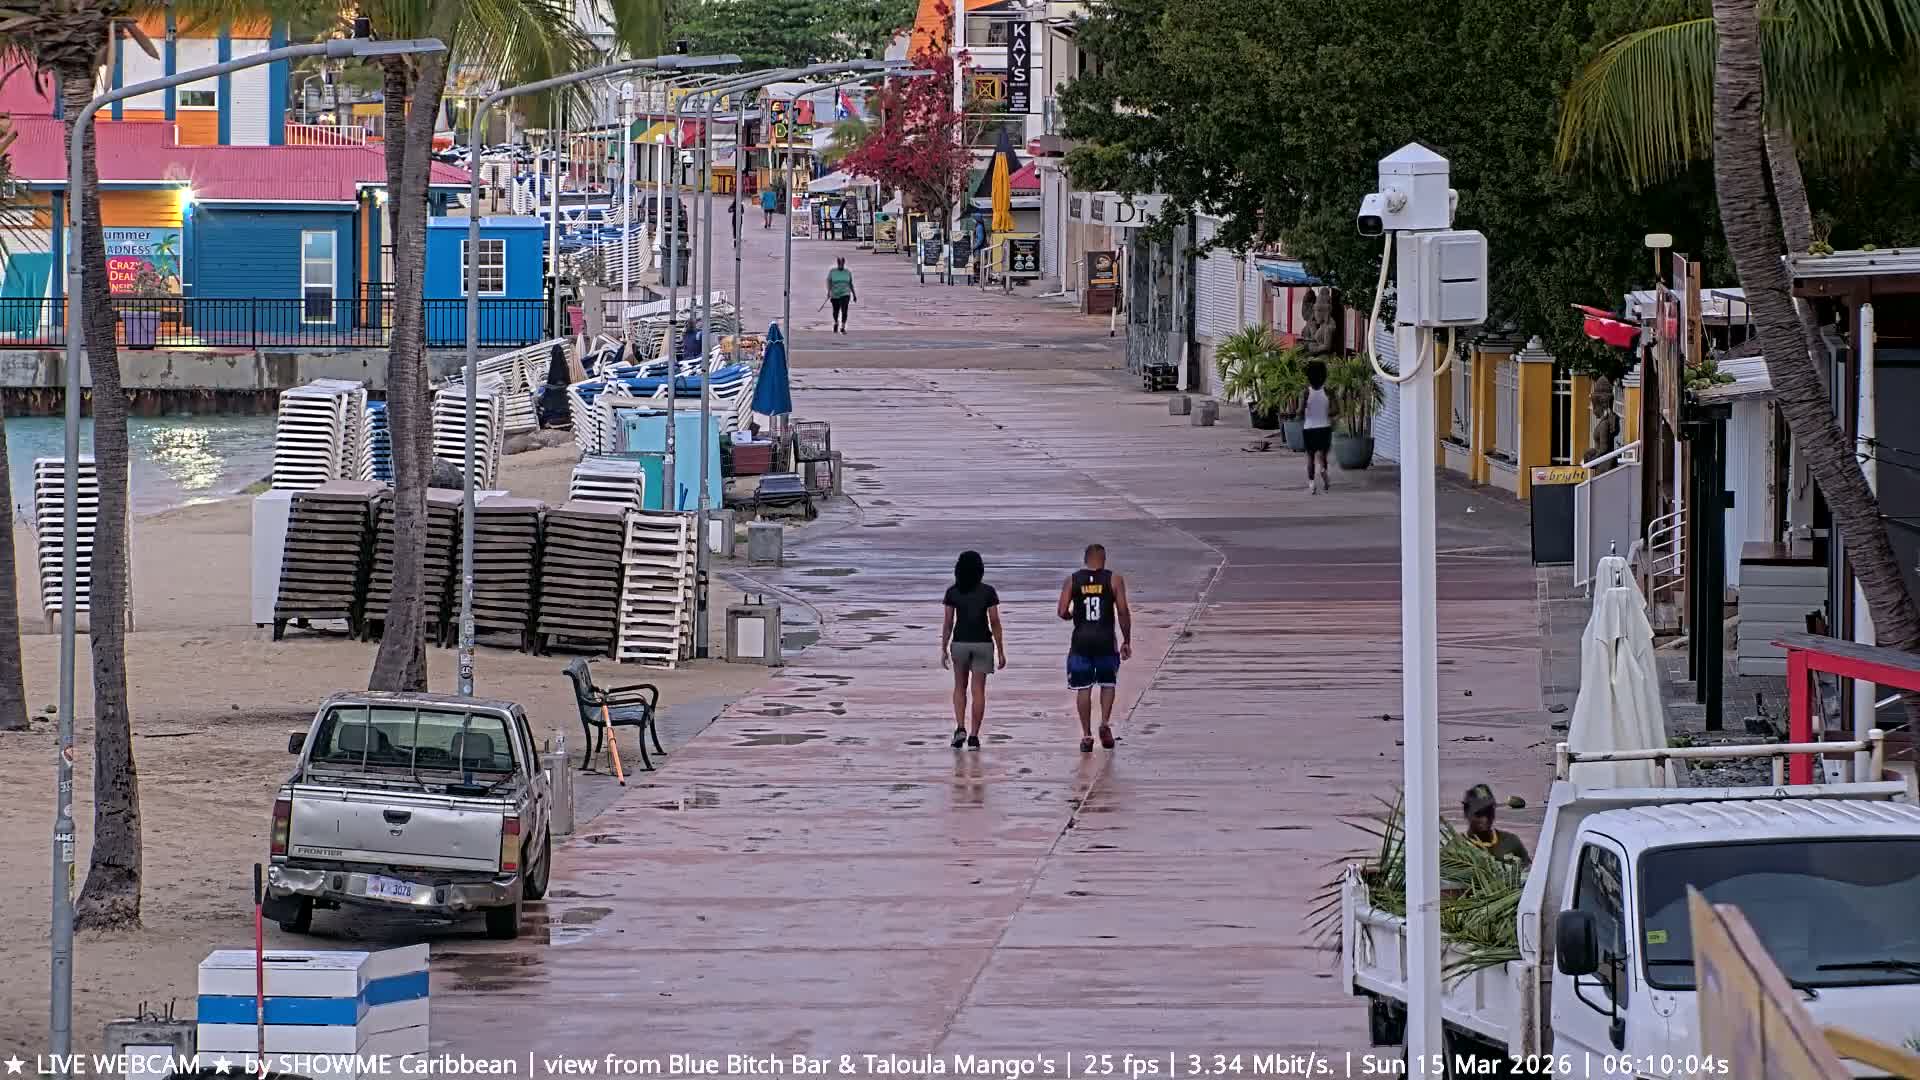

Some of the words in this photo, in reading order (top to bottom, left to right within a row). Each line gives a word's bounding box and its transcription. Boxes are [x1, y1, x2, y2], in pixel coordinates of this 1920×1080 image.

[1012, 23, 1027, 81] KAY'S
[103, 230, 152, 241] ummer
[106, 245, 152, 256] ADNESS
[109, 270, 136, 281] DEAL
[1083, 596, 1101, 621] 13
[298, 847, 342, 857] FRONTIER
[392, 884, 412, 897] 3078
